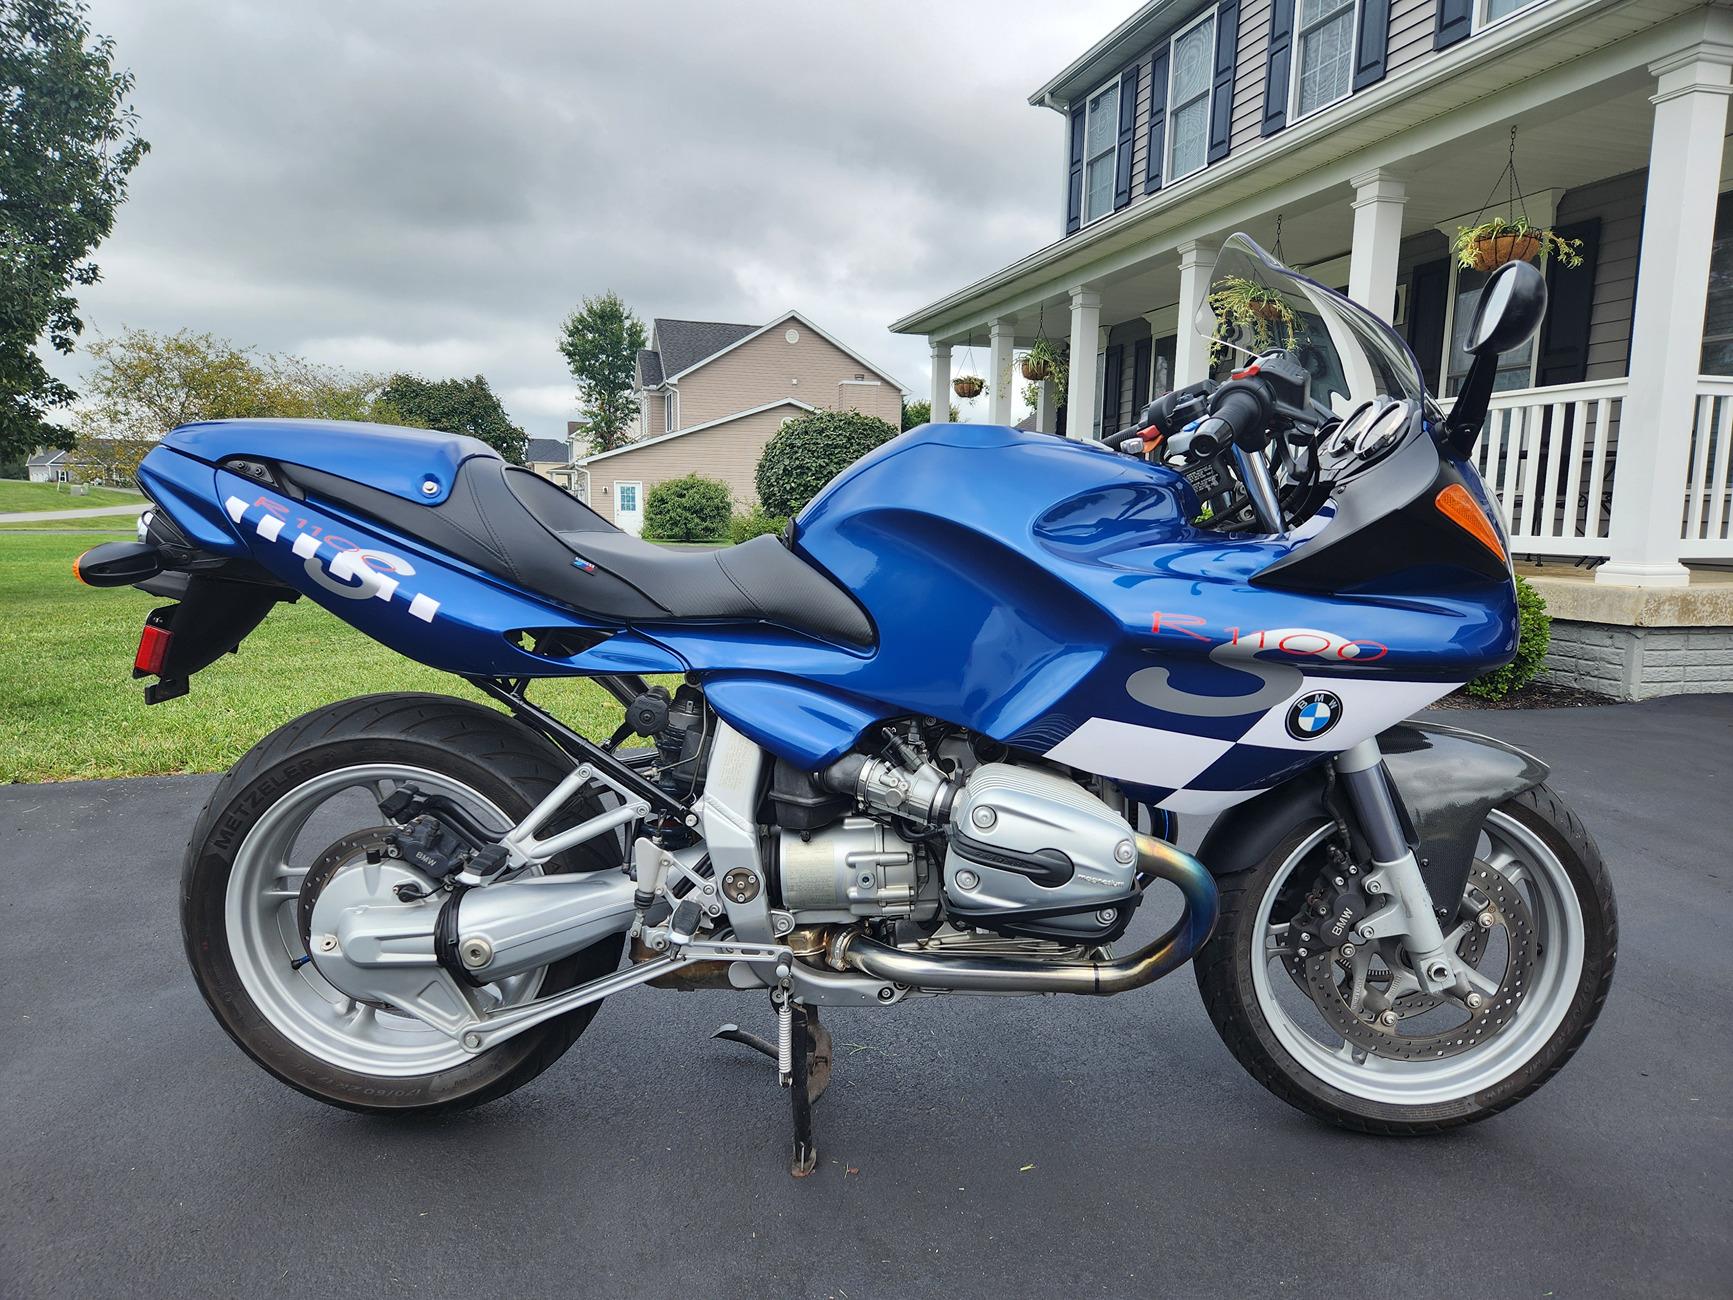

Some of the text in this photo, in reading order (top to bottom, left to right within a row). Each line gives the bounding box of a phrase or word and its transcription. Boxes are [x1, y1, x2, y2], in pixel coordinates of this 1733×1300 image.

[1125, 627, 1361, 718] S
[213, 758, 314, 851] METZELER
[415, 851, 437, 867] BMW
[1331, 906, 1353, 936] BMW
